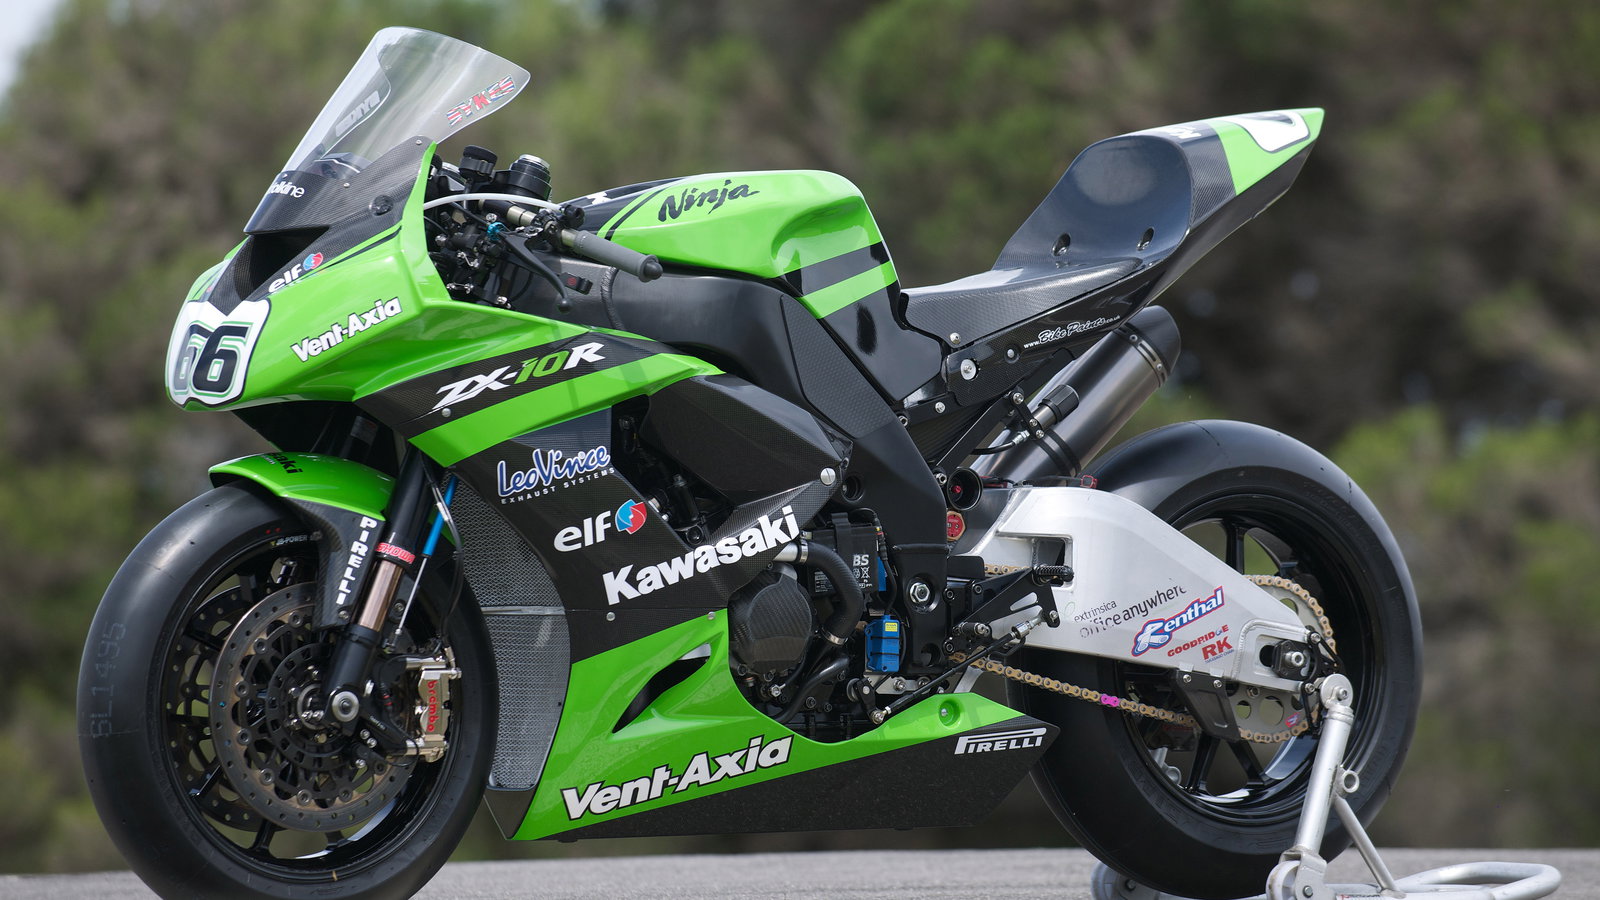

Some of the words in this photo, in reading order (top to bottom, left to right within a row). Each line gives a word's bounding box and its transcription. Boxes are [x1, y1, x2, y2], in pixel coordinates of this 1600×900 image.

[446, 75, 516, 126] SYKES
[658, 179, 760, 222] Ninja
[268, 263, 303, 292] elf
[290, 297, 403, 363] Vent-Axia
[173, 320, 254, 398] 66
[432, 342, 606, 410] ZX-10R
[497, 445, 611, 497] LeoVince
[501, 486, 556, 504] EXHAUST
[563, 467, 615, 488] SYSTEMS
[375, 542, 416, 565] SHOWA
[554, 510, 612, 552] elf
[336, 516, 378, 606] PIRELLI
[602, 504, 801, 606] Kawasaki
[852, 554, 870, 568] BS
[1073, 600, 1118, 623] extrinsica
[1132, 586, 1225, 657] Renthal
[1167, 624, 1230, 658] GOODRIDGE
[1201, 636, 1233, 661] RK
[427, 680, 439, 732] brembo
[954, 727, 1047, 755] PIRELLI
[560, 734, 794, 821] Vent-Axia
